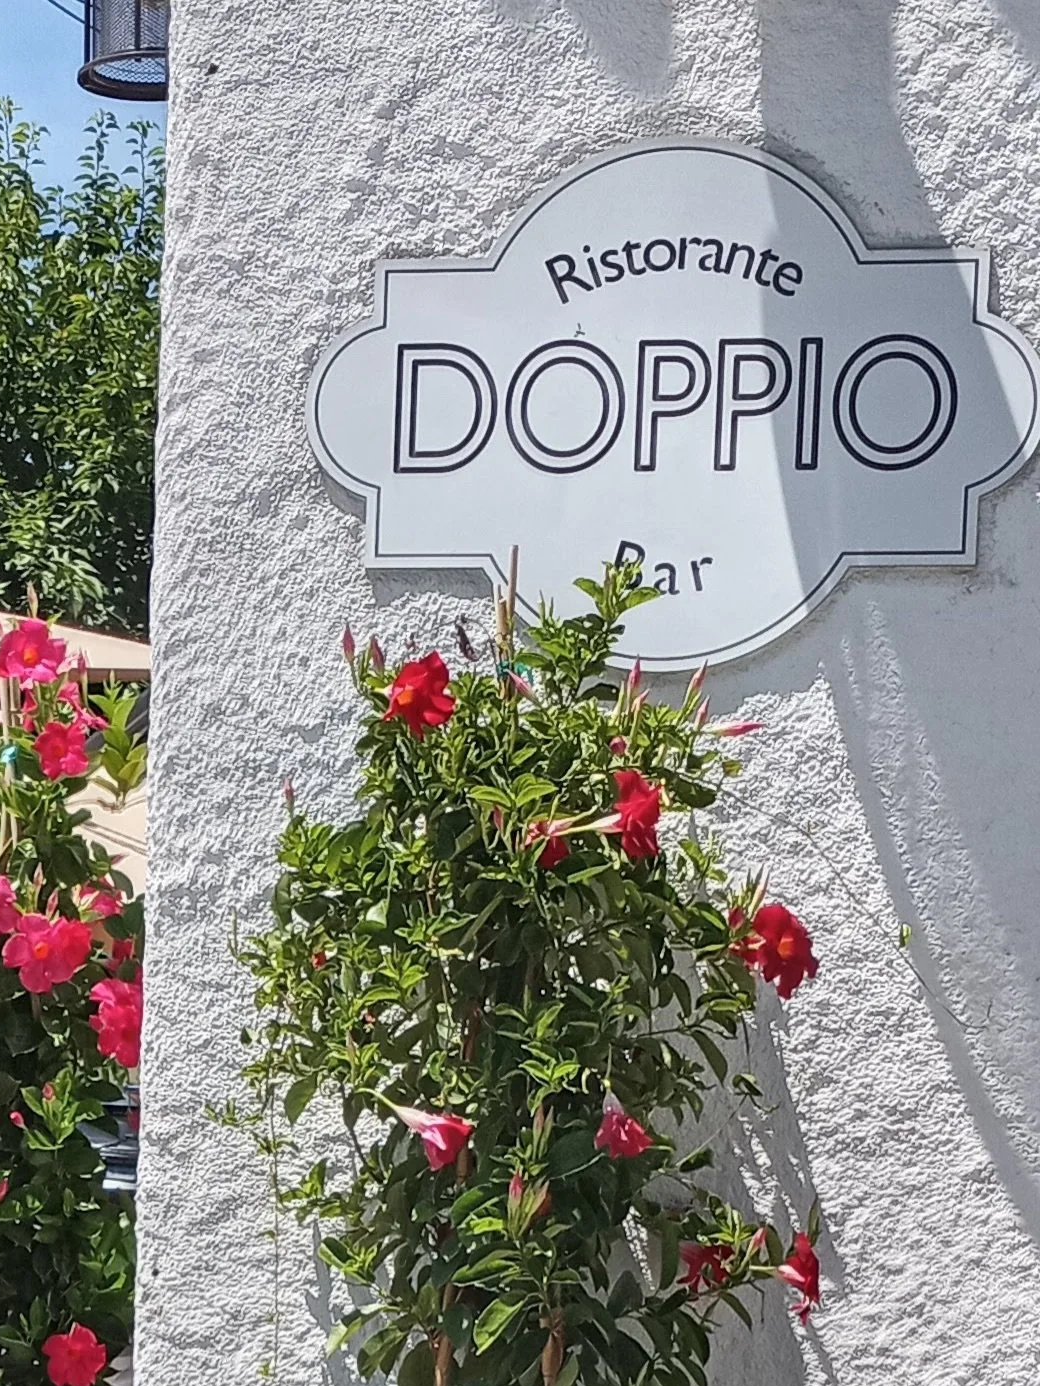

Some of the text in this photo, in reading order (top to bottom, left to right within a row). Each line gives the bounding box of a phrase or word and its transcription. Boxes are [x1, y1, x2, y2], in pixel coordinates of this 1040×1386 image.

[545, 236, 804, 305] Ristorante
[393, 334, 958, 474] DOPPIO
[613, 540, 713, 596] Bar
